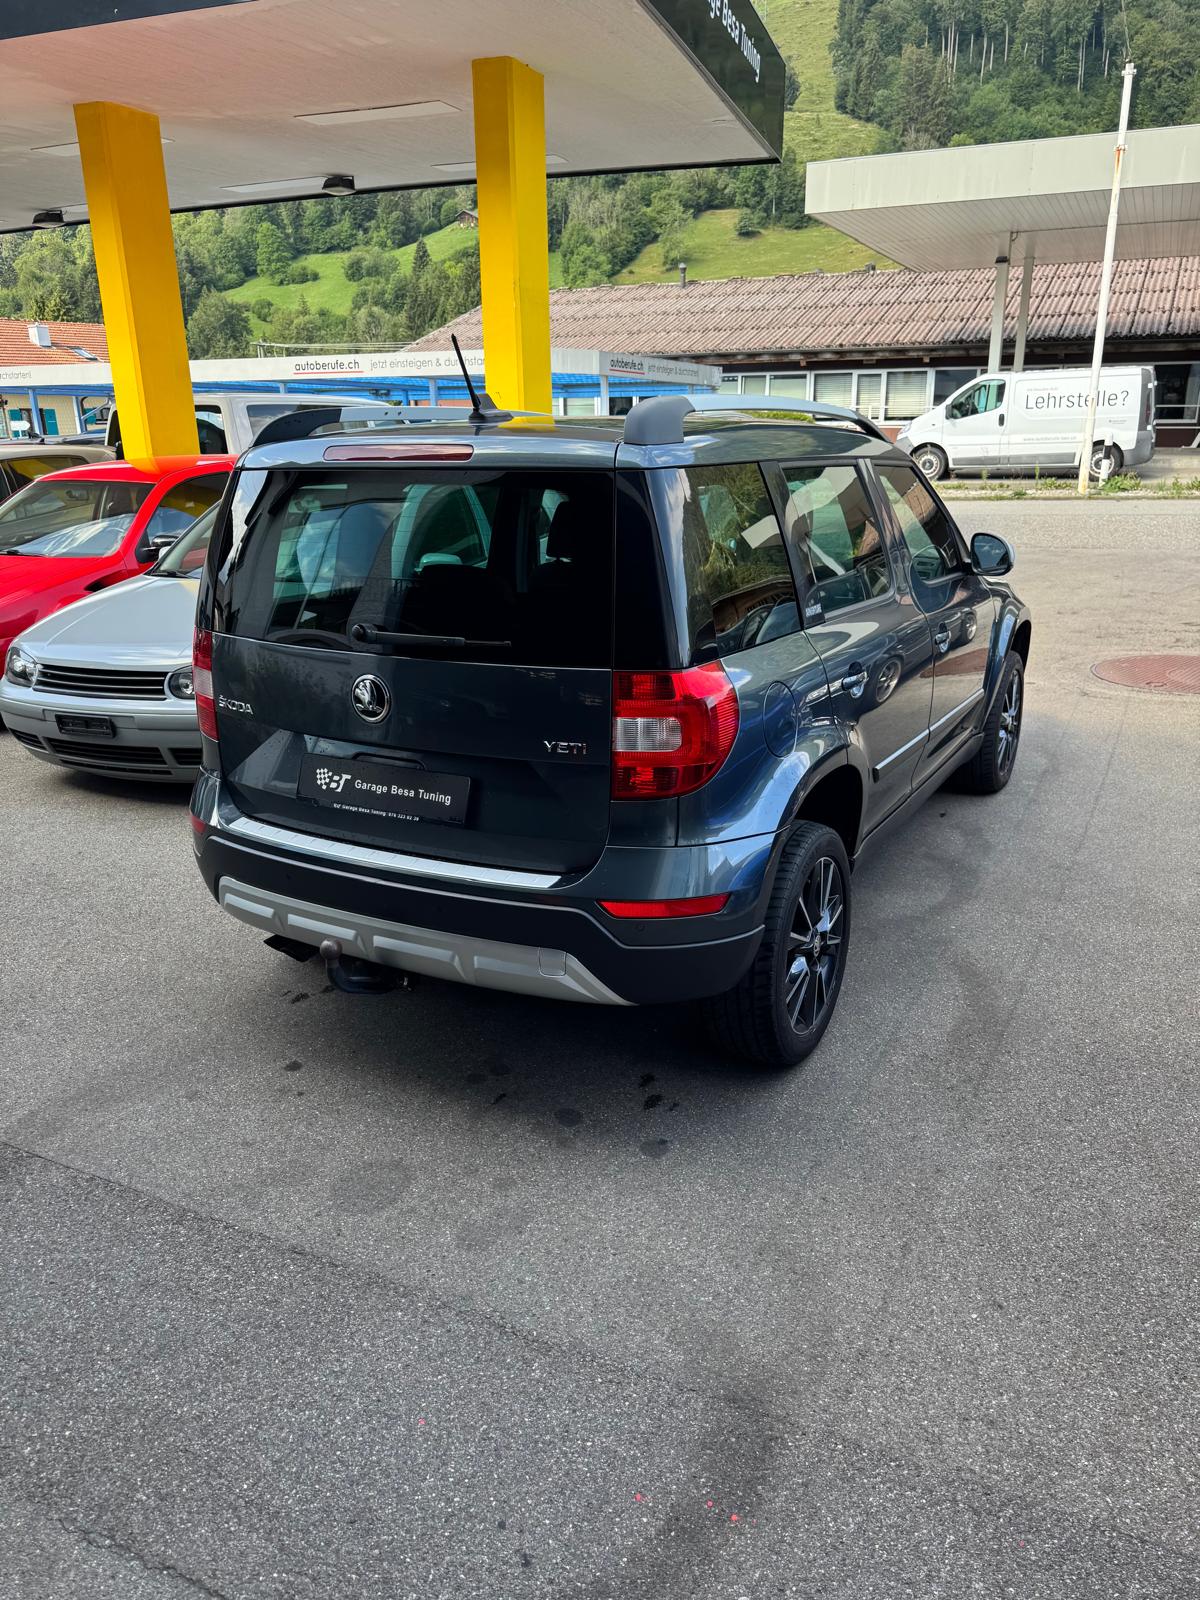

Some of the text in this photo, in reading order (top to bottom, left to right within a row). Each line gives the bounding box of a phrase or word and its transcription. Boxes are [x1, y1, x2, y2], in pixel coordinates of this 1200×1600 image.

[722, 0, 740, 45] Besa
[741, 23, 761, 83] Tuning
[294, 359, 360, 371] autoberufe.ch
[370, 359, 387, 371] jetzt
[389, 358, 433, 370] einsteigen
[435, 357, 442, 367] &
[610, 357, 644, 371] autoberufe.ch
[354, 779, 388, 794] Garage
[391, 785, 415, 798] Besa
[418, 788, 452, 806] Tuning
